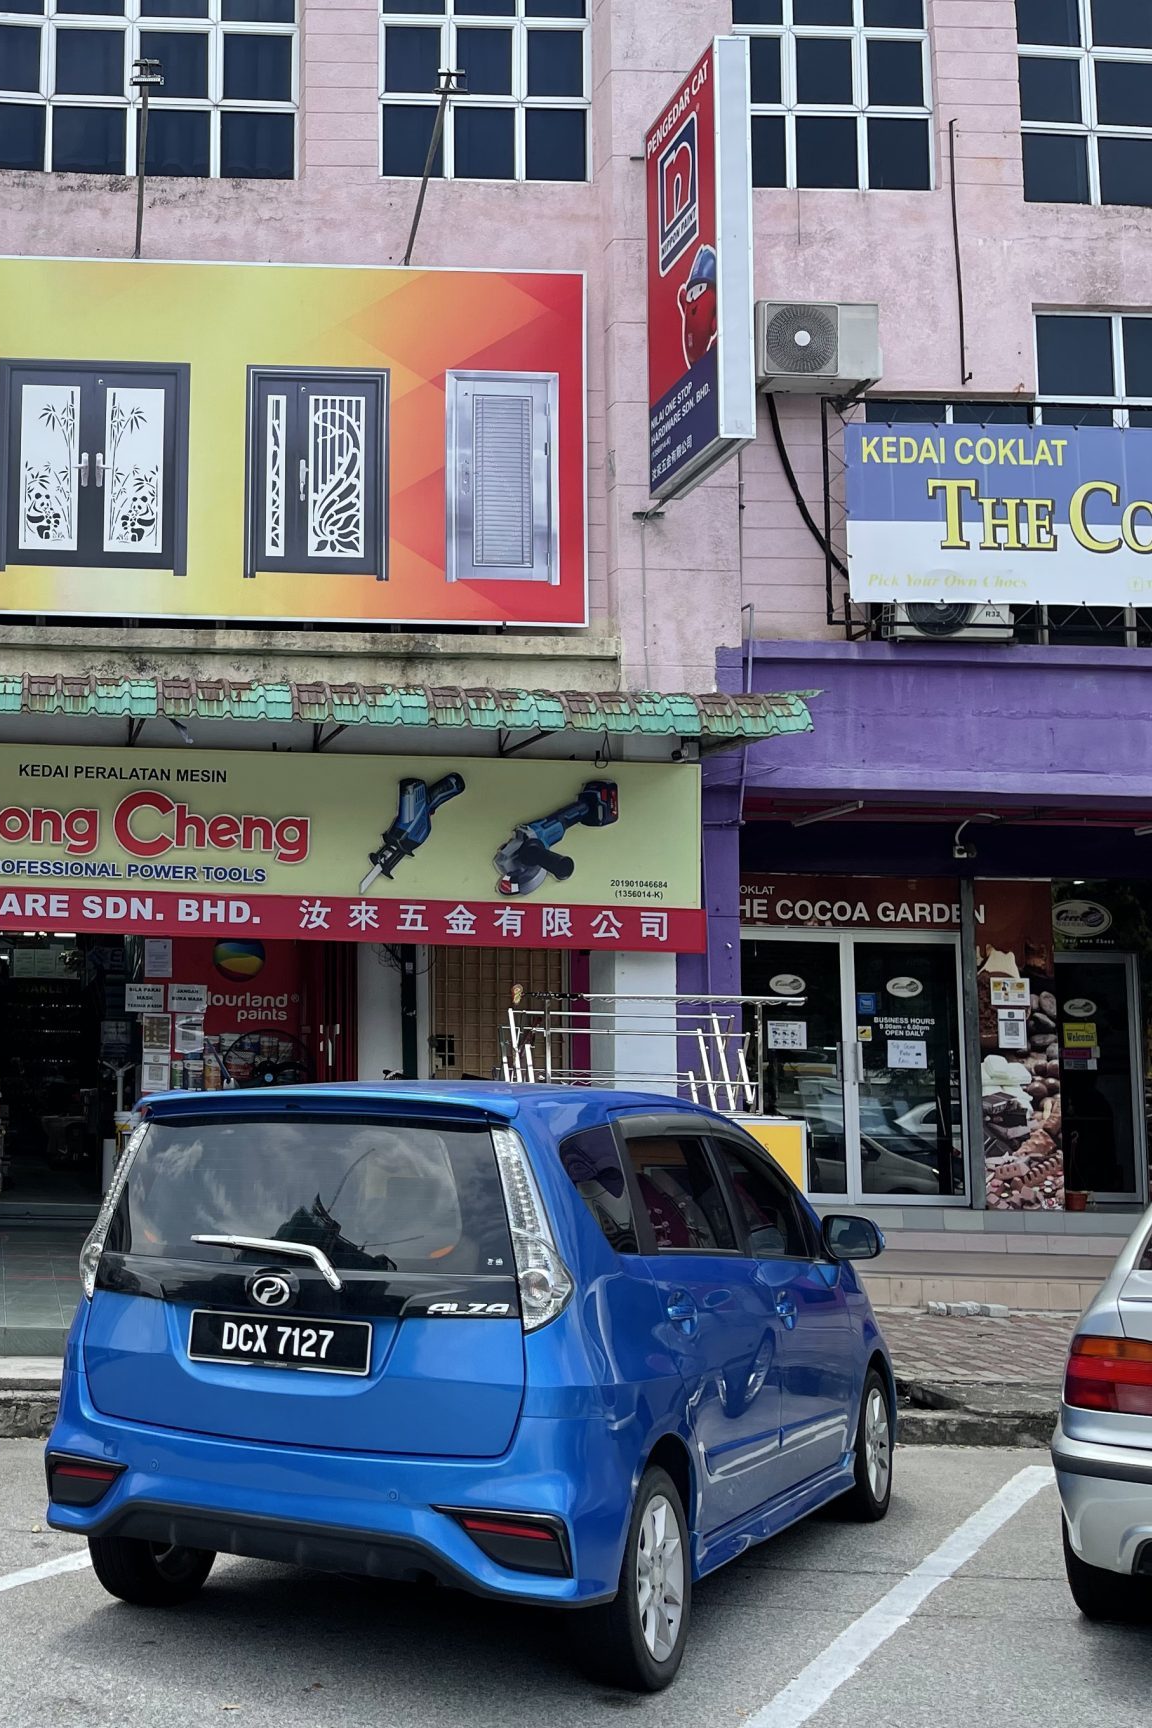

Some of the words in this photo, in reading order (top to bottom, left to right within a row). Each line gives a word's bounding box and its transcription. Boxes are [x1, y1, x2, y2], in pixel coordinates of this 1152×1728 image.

[647, 89, 690, 160] PENGEDAR
[691, 60, 709, 96] CAT
[661, 230, 681, 259] NIPPON
[680, 207, 697, 236] PAINT
[651, 411, 665, 432] NILAI
[664, 398, 677, 417] ONE
[677, 381, 693, 404] STOP
[651, 411, 682, 447] HARDWARE
[682, 397, 696, 418] SDN.
[696, 382, 711, 405] BHD.
[861, 436, 946, 464] KEDAI
[954, 438, 1068, 467] COKLAT
[927, 478, 1058, 551] THE
[867, 574, 899, 588] Pick
[905, 574, 941, 588] Your
[944, 575, 978, 588] Own
[18, 764, 70, 779] KEDAI
[74, 766, 171, 781] PERALATAN
[176, 768, 228, 784] MESIN
[113, 789, 311, 863] Cheng
[127, 863, 198, 881] POWER
[203, 866, 267, 883] TOOLS
[610, 879, 668, 889] 201901046684
[614, 889, 663, 900] (1356014-K)
[739, 885, 775, 896] OKLAT
[82, 895, 164, 921] SDN.
[177, 898, 261, 924] BHD.
[298, 899, 669, 942] 汝來五金有限公司
[739, 898, 768, 918] HE
[775, 899, 871, 922] COCOA
[877, 902, 985, 924] GARDEN
[206, 992, 288, 1008] lourland
[237, 1008, 288, 1023] paints
[873, 1016, 909, 1024] BUSINESS
[910, 1017, 936, 1025] HOURS
[1067, 1031, 1095, 1042] Welcome
[427, 1303, 510, 1315] ALZA
[222, 1322, 268, 1353] DCX
[276, 1325, 335, 1359] 7127
